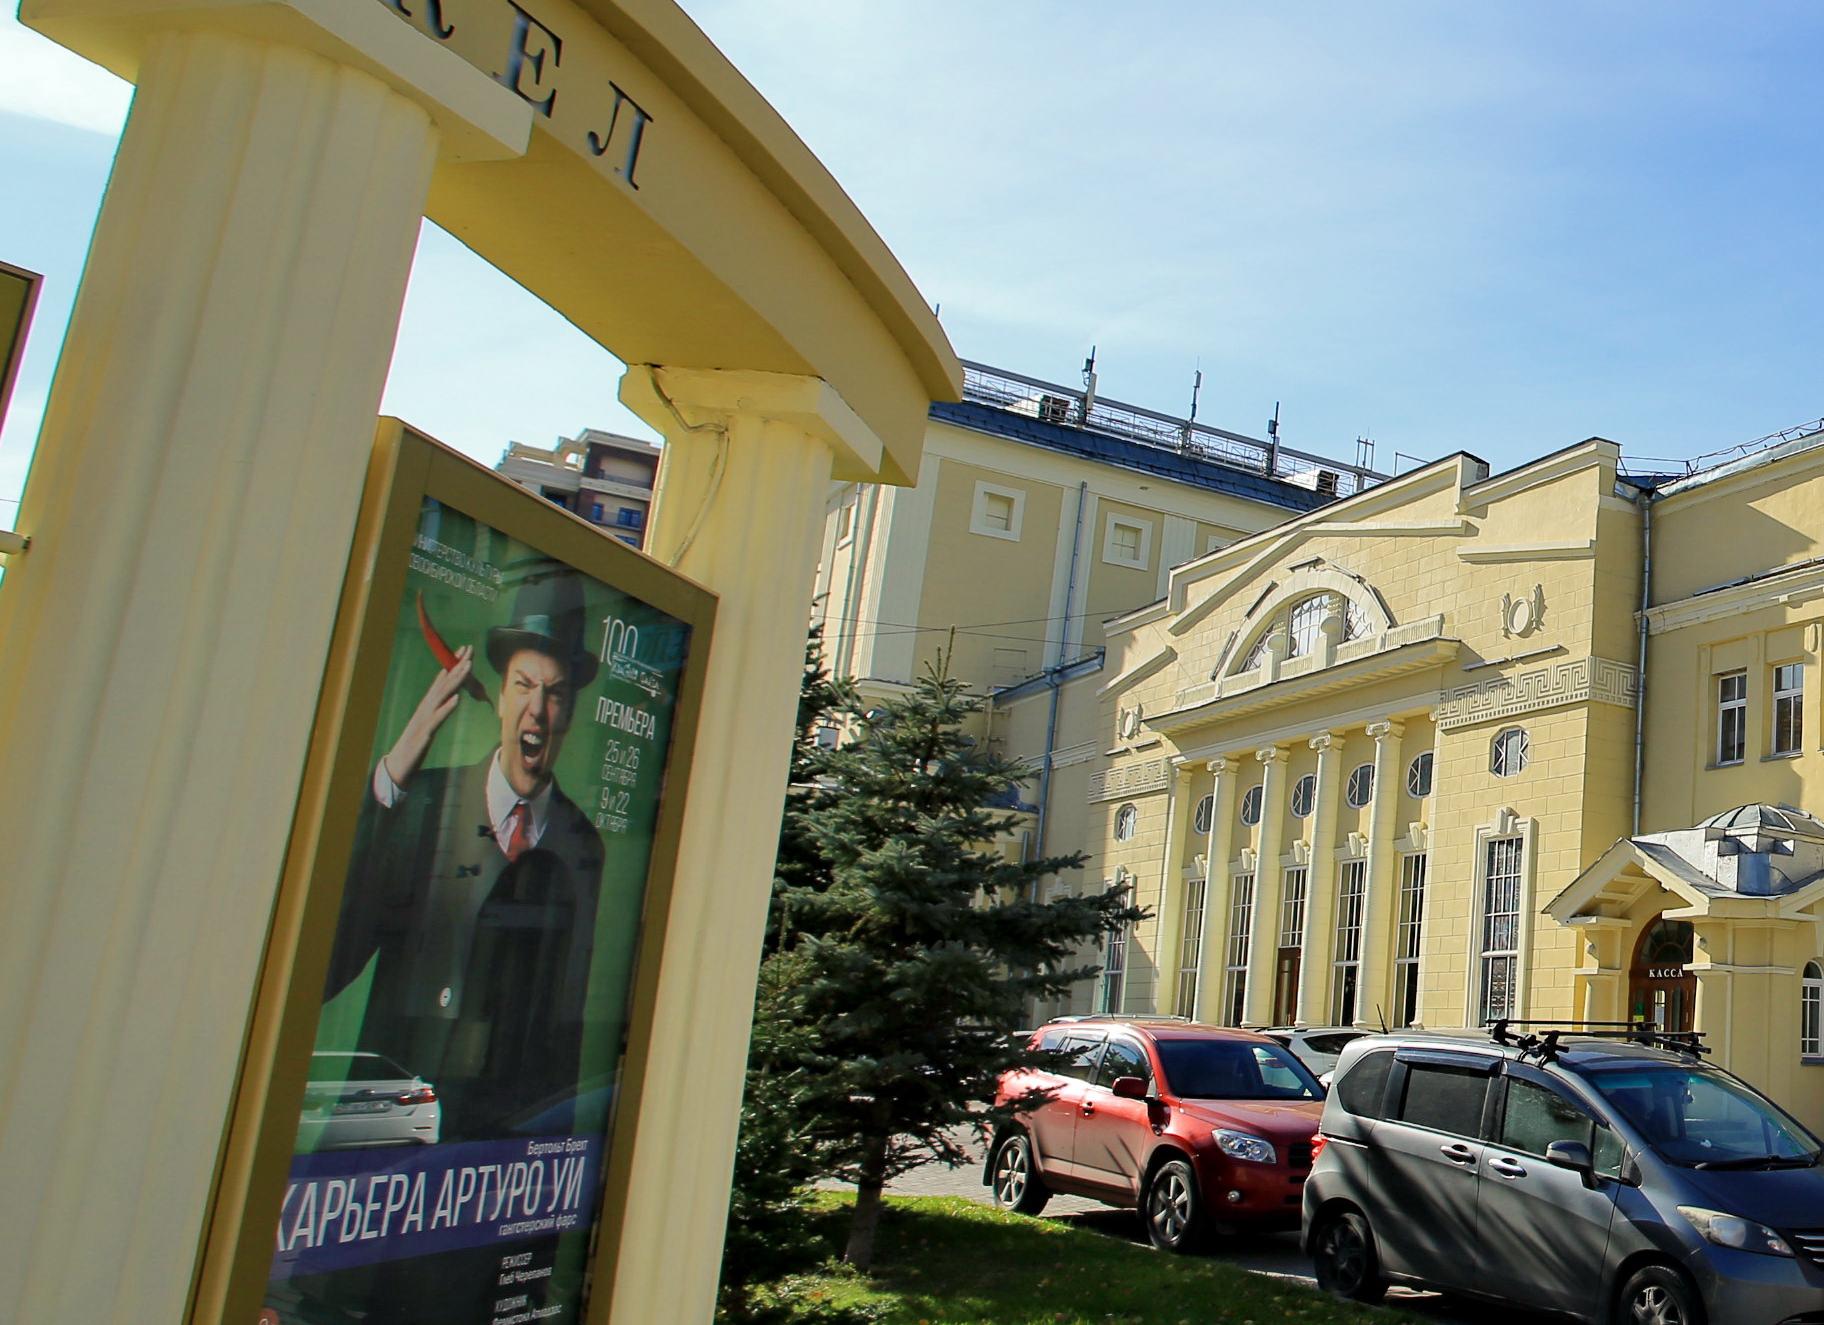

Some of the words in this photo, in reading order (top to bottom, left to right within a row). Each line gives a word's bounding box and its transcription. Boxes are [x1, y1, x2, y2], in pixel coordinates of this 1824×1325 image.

[392, 0, 654, 190] ЕЛ
[600, 615, 639, 667] 100
[595, 696, 656, 740] ПРЕМЬЕРА
[605, 739, 621, 763] 25
[626, 745, 640, 769] 26
[600, 786, 610, 810] 9
[615, 790, 631, 815] 22
[1648, 968, 1683, 978] КАССА
[565, 1138, 589, 1155] Брехт
[430, 1160, 545, 1230] АРТУРО
[546, 1156, 585, 1213] УИ
[555, 1213, 578, 1230] фарс
